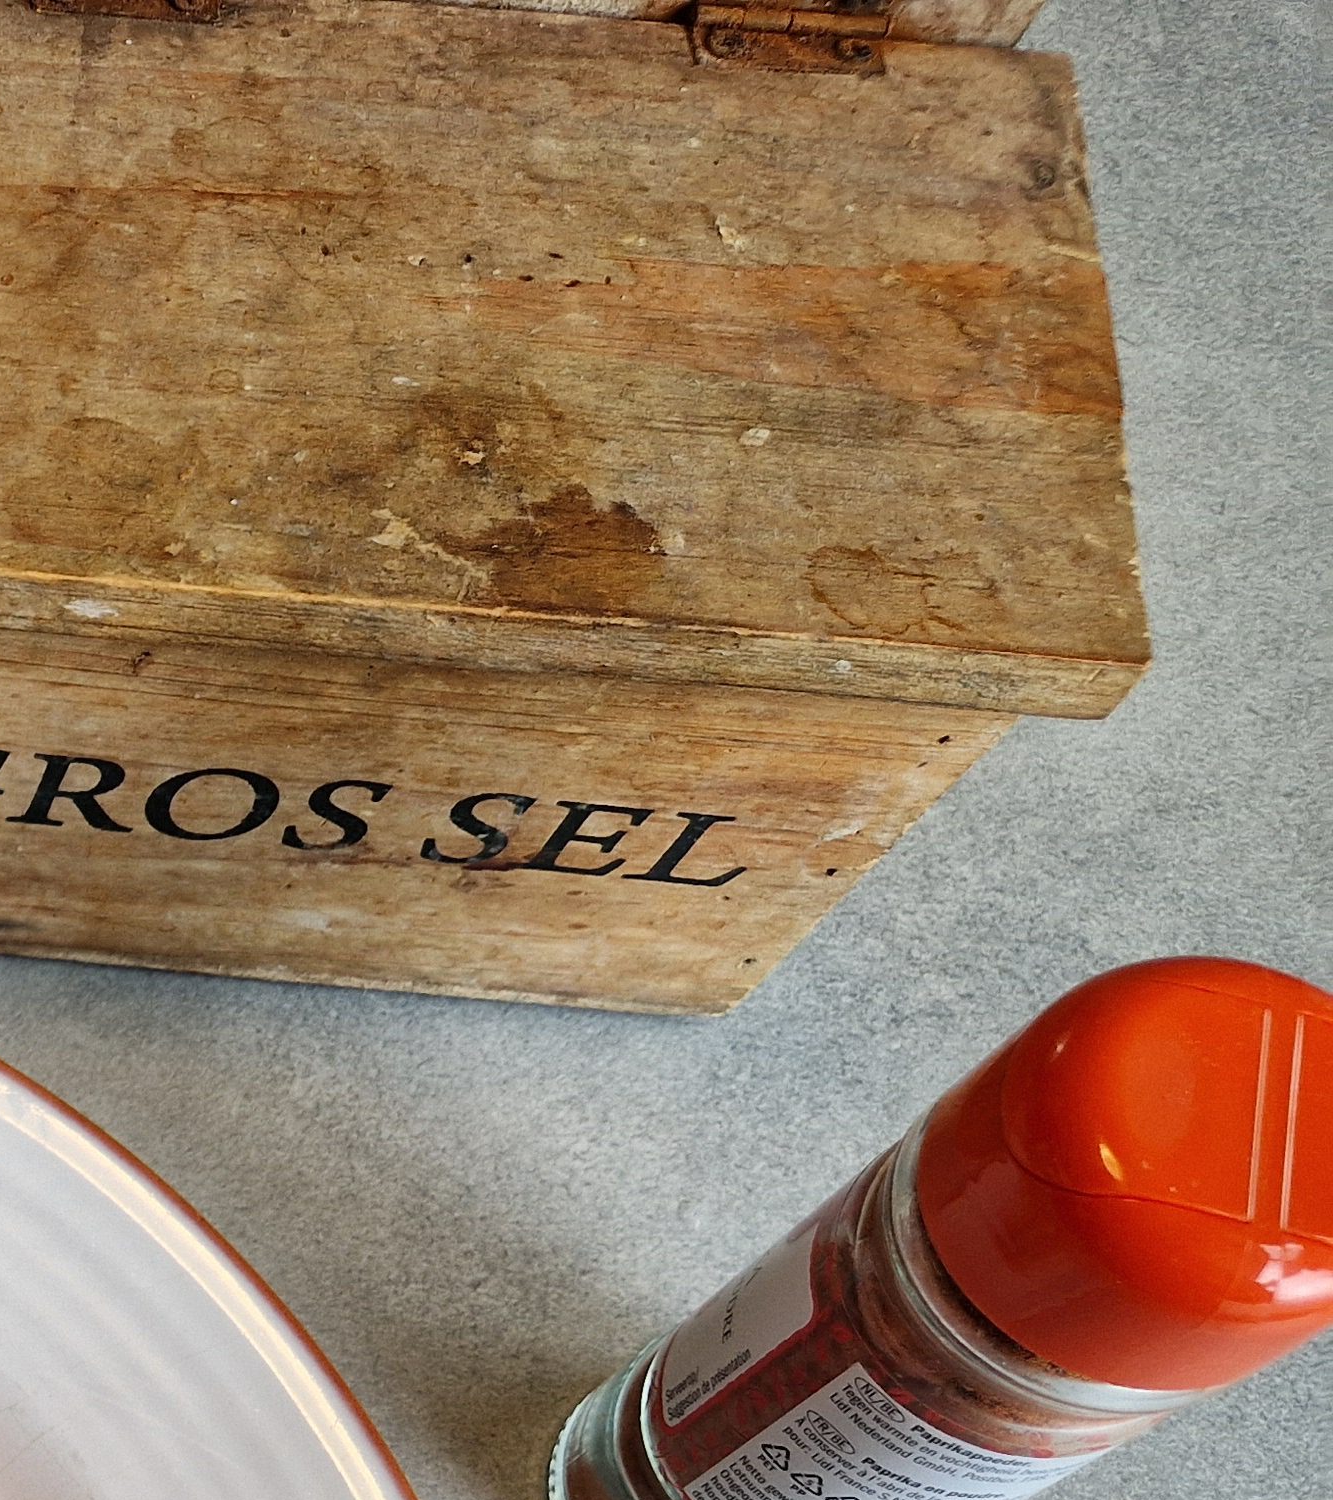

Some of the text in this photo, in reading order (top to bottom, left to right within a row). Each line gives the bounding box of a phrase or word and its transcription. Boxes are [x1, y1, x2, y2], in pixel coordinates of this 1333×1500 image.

[418, 790, 750, 890] SEL
[841, 1383, 873, 1415] Tegen
[872, 1414, 918, 1447] warmte
[919, 1446, 938, 1457] en
[860, 1382, 898, 1419] NL/BE
[812, 1415, 849, 1451] FR/BE
[829, 1392, 852, 1414] Lidl
[849, 1412, 913, 1459] Nederland
[739, 1454, 767, 1484] Netto
[757, 1453, 778, 1471] PET
[803, 1427, 858, 1471] conserver
[906, 1490, 925, 1500] de
[811, 1452, 835, 1471] Lidl
[834, 1469, 877, 1496] France
[861, 1456, 922, 1488] Paprika
[924, 1485, 946, 1495] en
[790, 1484, 807, 1496] PP
